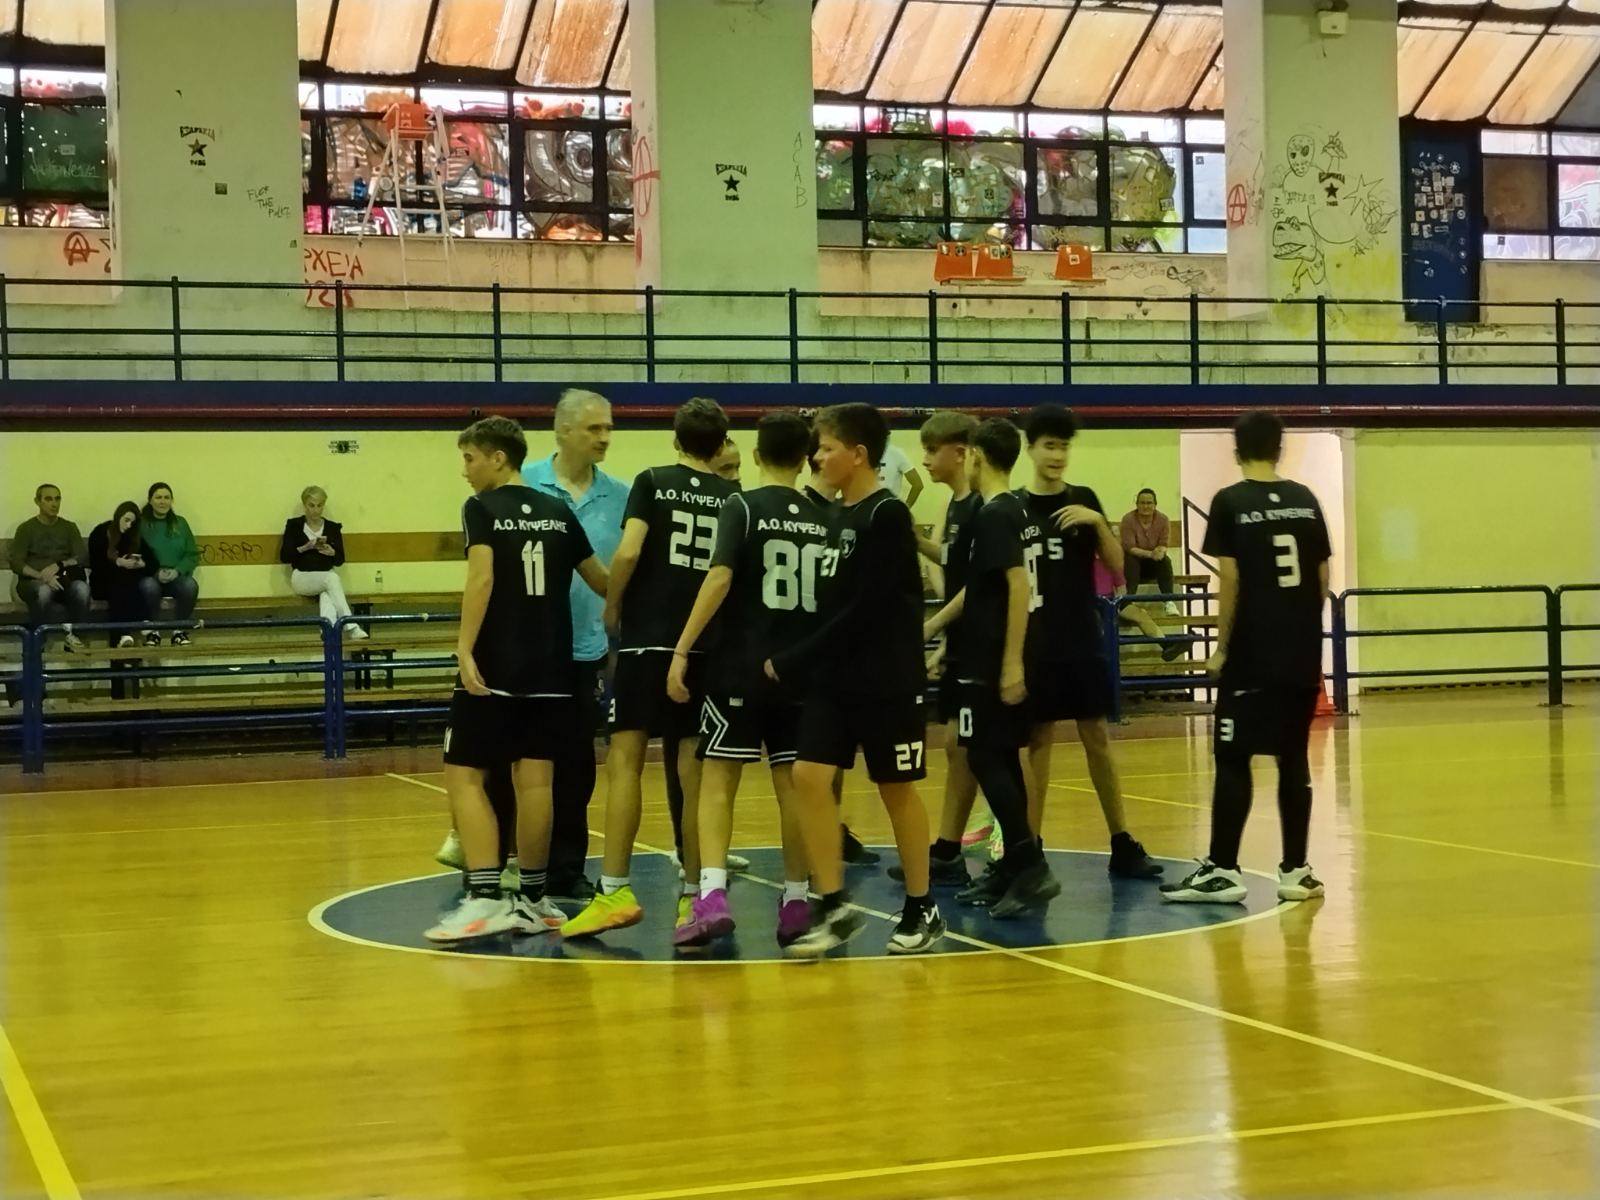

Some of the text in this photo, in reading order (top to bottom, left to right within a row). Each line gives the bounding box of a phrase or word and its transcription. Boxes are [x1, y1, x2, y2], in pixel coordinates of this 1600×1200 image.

[669, 509, 719, 571] 23
[1047, 537, 1064, 560] 5
[521, 540, 546, 596] 11
[820, 547, 840, 577] 27
[1272, 534, 1301, 587] 3
[1220, 718, 1235, 742] 3
[895, 740, 923, 771] 27
